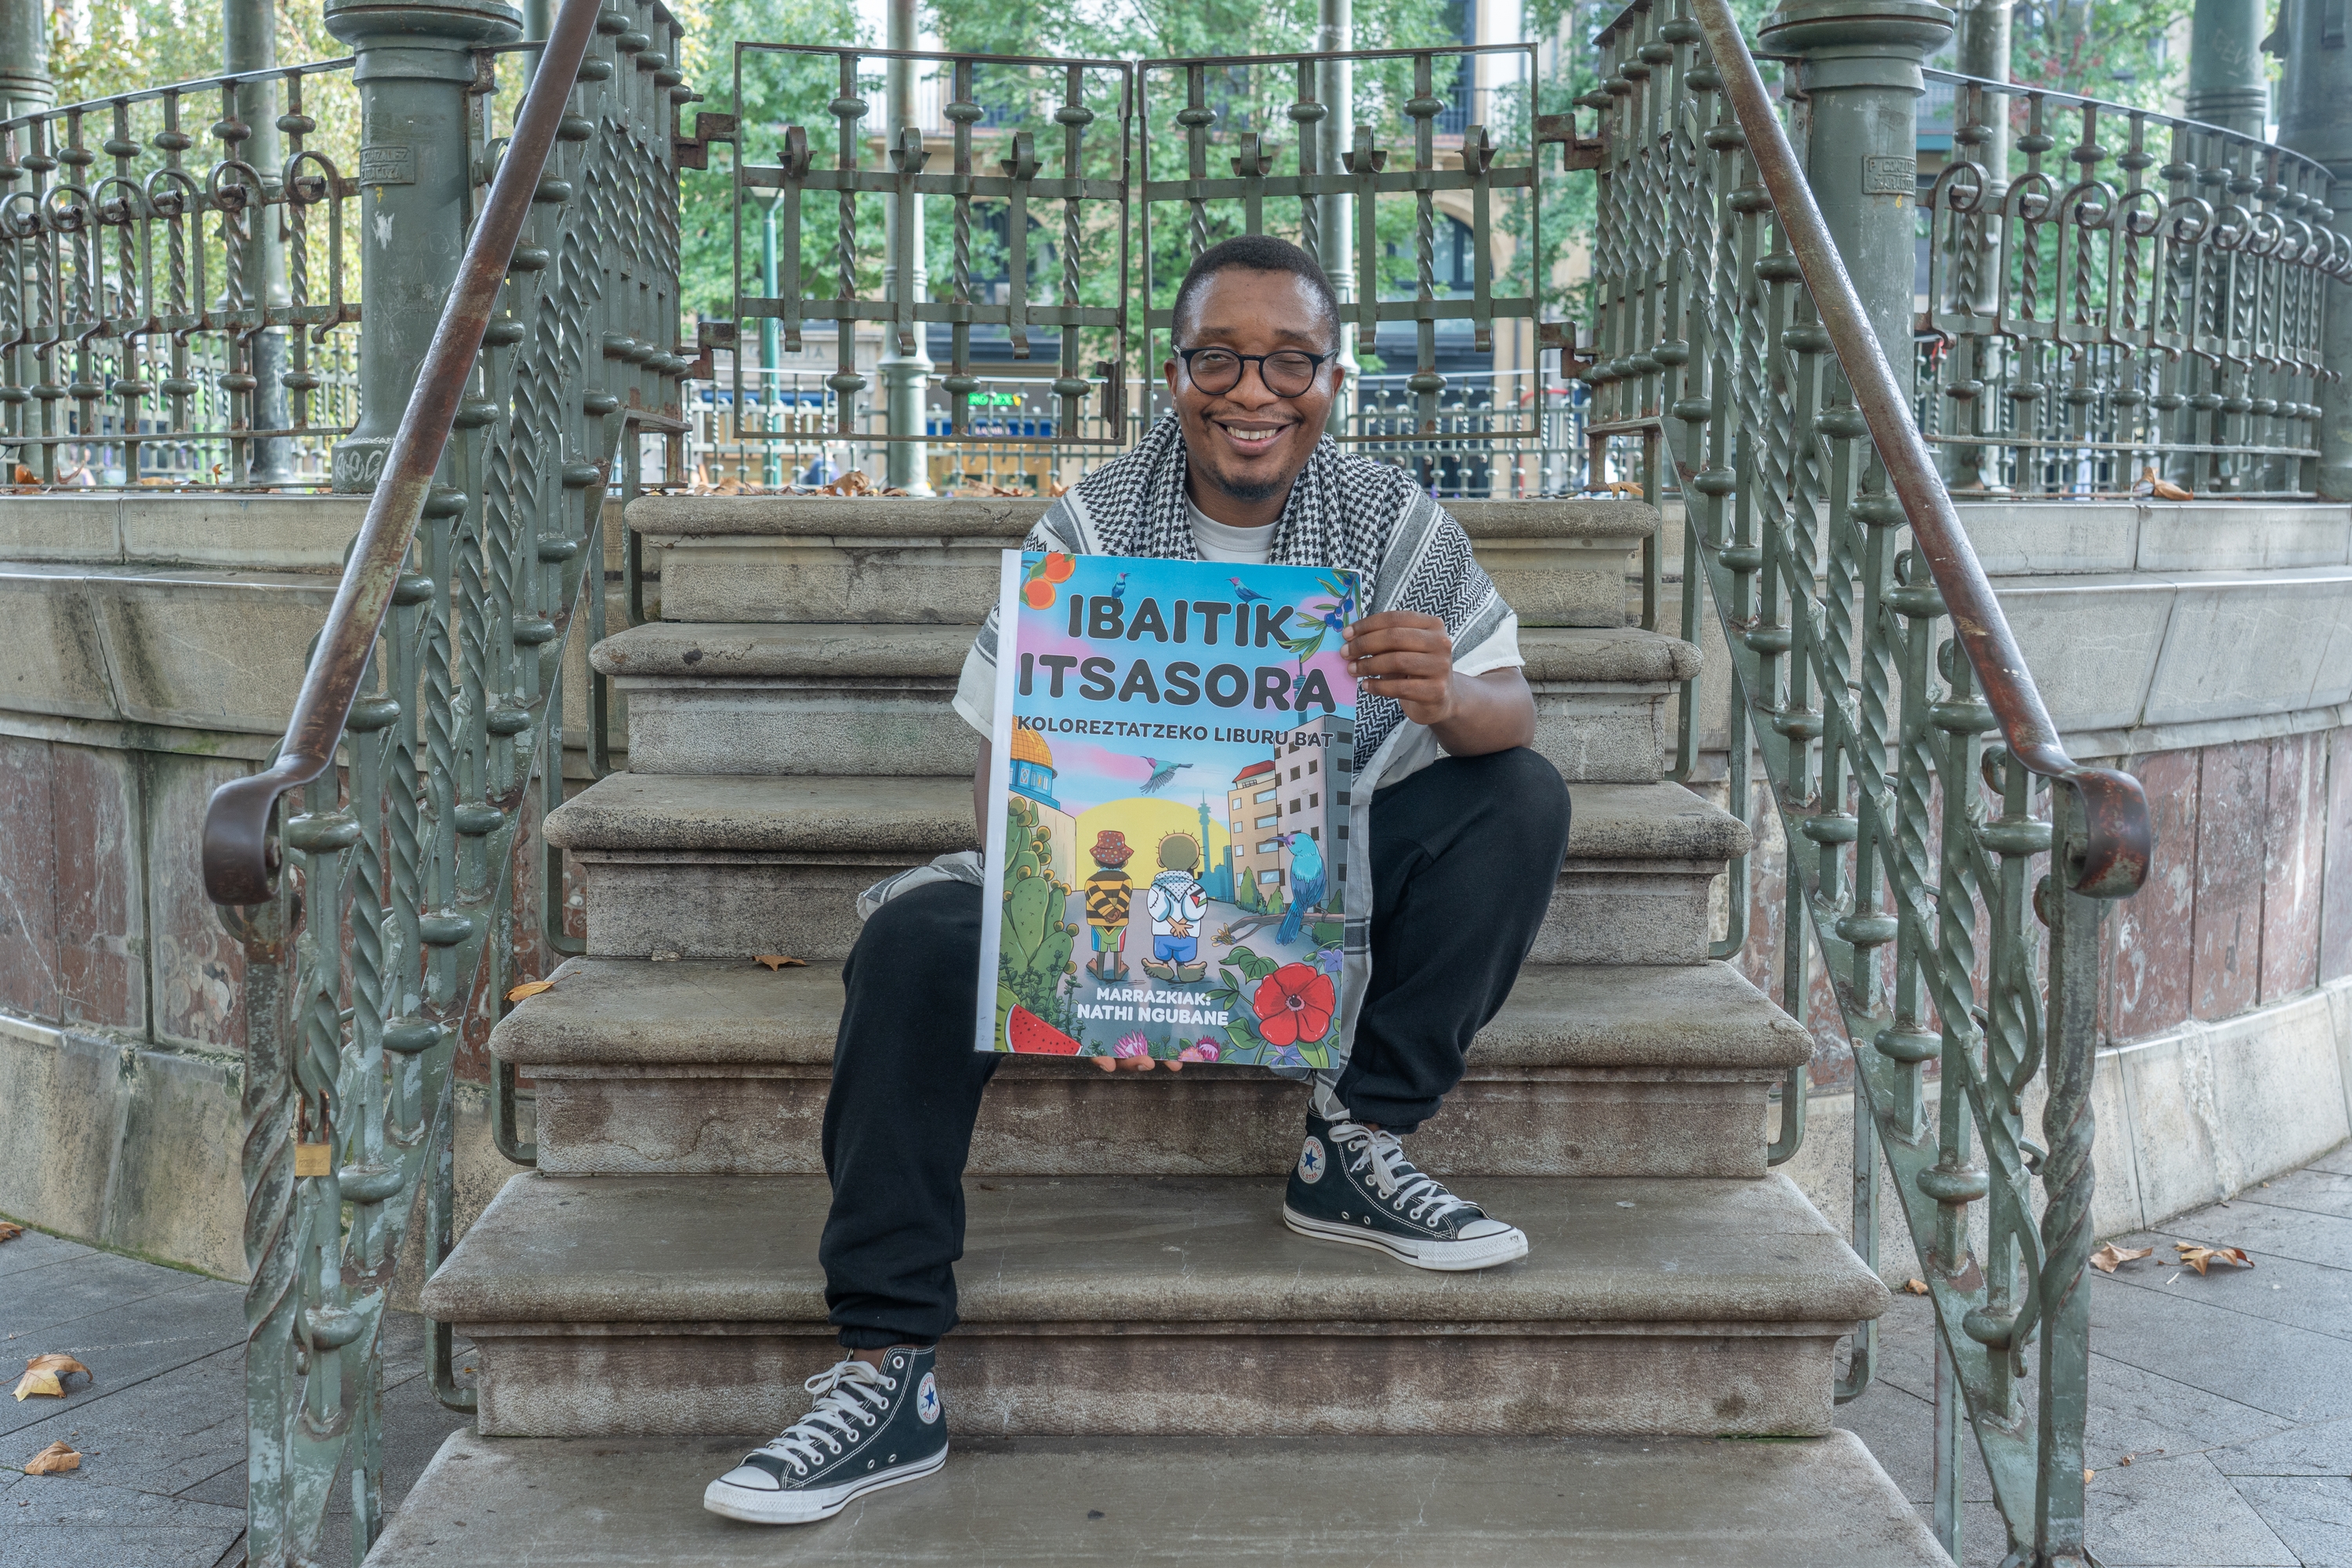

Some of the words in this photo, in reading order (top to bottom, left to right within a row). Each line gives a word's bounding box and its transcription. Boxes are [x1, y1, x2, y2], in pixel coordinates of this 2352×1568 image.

[1896, 194, 1903, 209] 6
[1069, 593, 1296, 649] IBAITIK
[1018, 652, 1337, 713] ITSASORA
[1017, 714, 1208, 742] KOLOREZTATZEKO
[1214, 726, 1289, 746] LIBURU
[1294, 731, 1334, 748] BAT
[1096, 987, 1211, 1007] MARRAZKIAK:
[1077, 1004, 1134, 1021] NATHI
[1138, 1007, 1229, 1026] NGUBANE
[1304, 1140, 1323, 1159] CONVERSE
[1305, 1171, 1318, 1180] STAR
